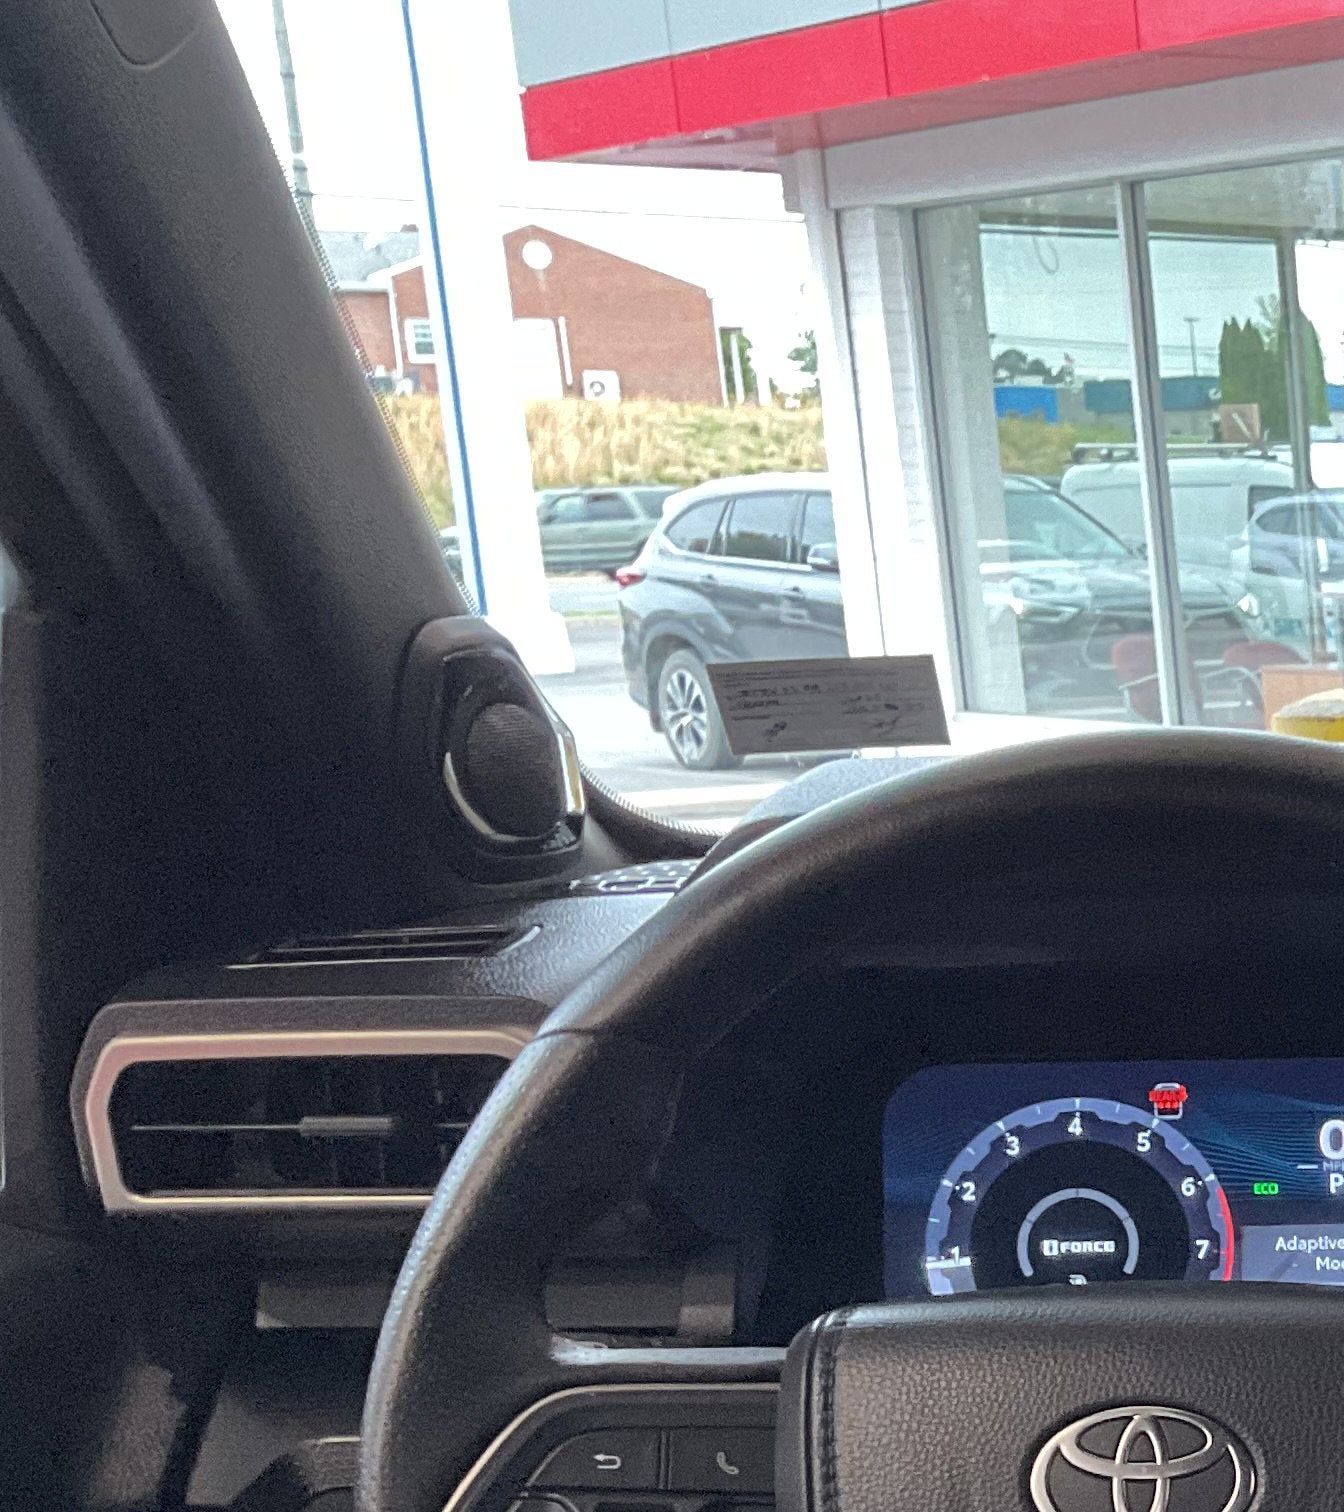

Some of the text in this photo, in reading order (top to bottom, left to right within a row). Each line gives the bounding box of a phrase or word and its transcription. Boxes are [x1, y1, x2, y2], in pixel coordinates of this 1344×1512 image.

[1067, 1117, 1083, 1137] 4
[1007, 1136, 1021, 1156] 3
[1136, 1133, 1152, 1152] 5
[961, 1181, 976, 1201] 2
[1181, 1178, 1196, 1196] 6
[1253, 1182, 1279, 1195] ECO
[1329, 1173, 1344, 1194] P
[1196, 1240, 1210, 1259] 7
